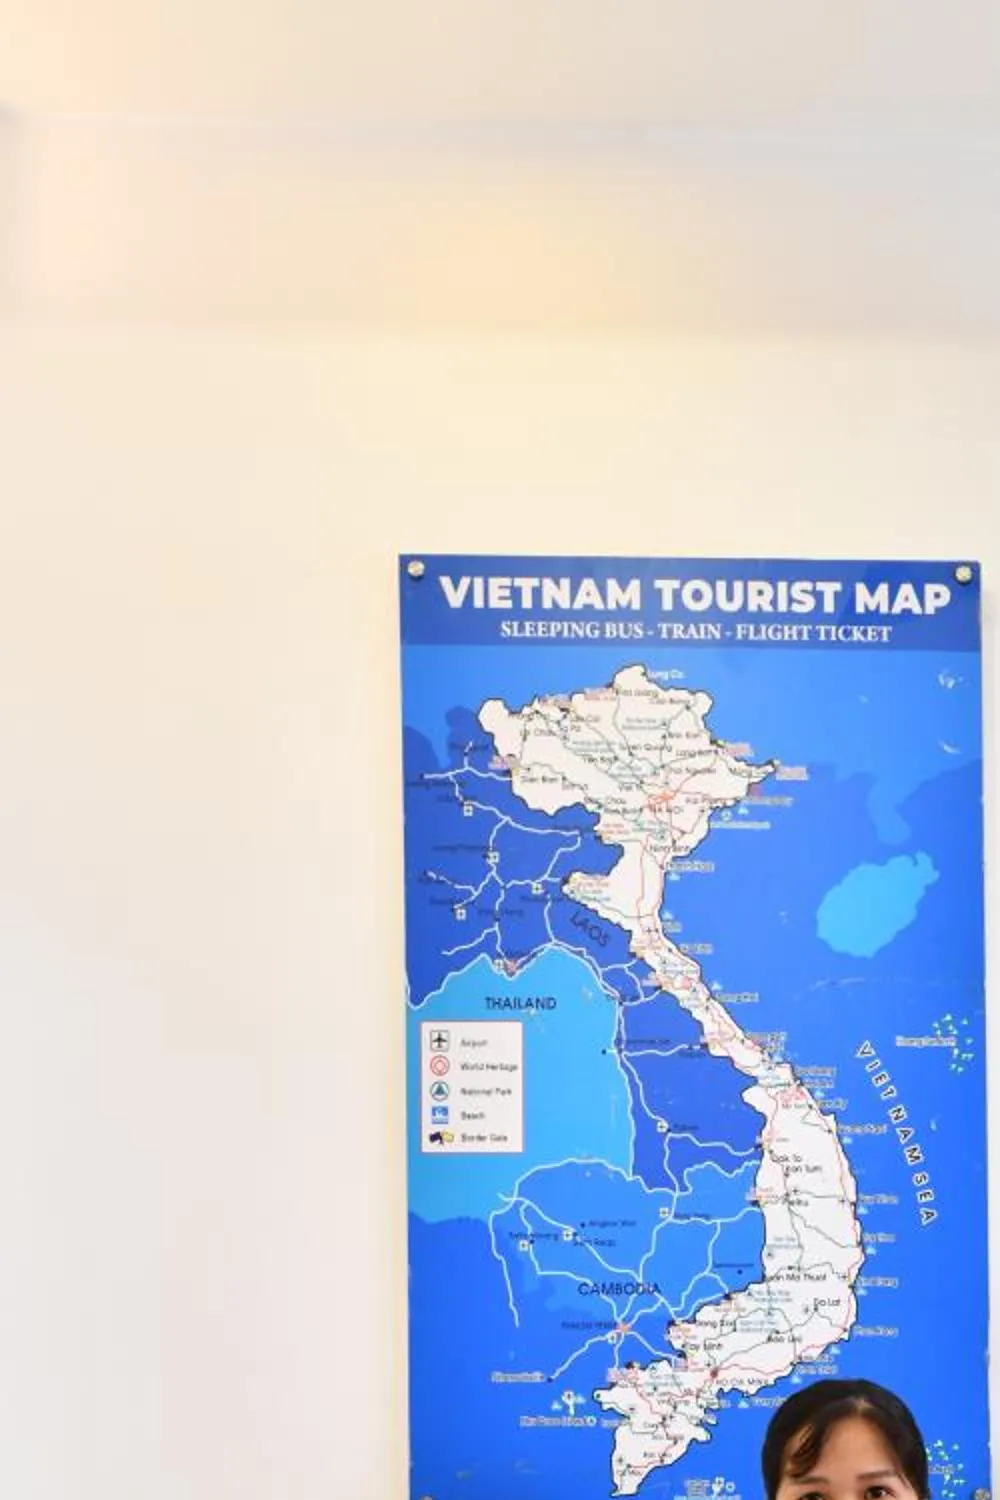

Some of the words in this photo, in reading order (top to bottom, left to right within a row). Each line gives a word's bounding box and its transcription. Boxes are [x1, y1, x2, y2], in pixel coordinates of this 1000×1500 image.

[439, 575, 642, 611] VIETNAM
[653, 579, 843, 614] TOURIST
[855, 582, 951, 615] MAP
[501, 620, 600, 639] SLEEPING
[604, 621, 644, 639] BUS
[657, 622, 722, 641] TRAIN
[735, 623, 812, 642] FLIGHT
[816, 625, 893, 642] TICKET
[570, 911, 611, 947] LAOS
[485, 996, 558, 1011] THAILAND
[460, 1038, 488, 1048] Airport
[460, 1063, 485, 1072] World
[486, 1063, 519, 1073] Heritage
[460, 1087, 492, 1097] National
[495, 1087, 512, 1096] Park
[460, 1111, 485, 1121] Beach
[460, 1132, 487, 1143] Border
[489, 1132, 509, 1143] Gate
[912, 1171, 938, 1226] SEA
[578, 1282, 662, 1297] CAMBODIA
